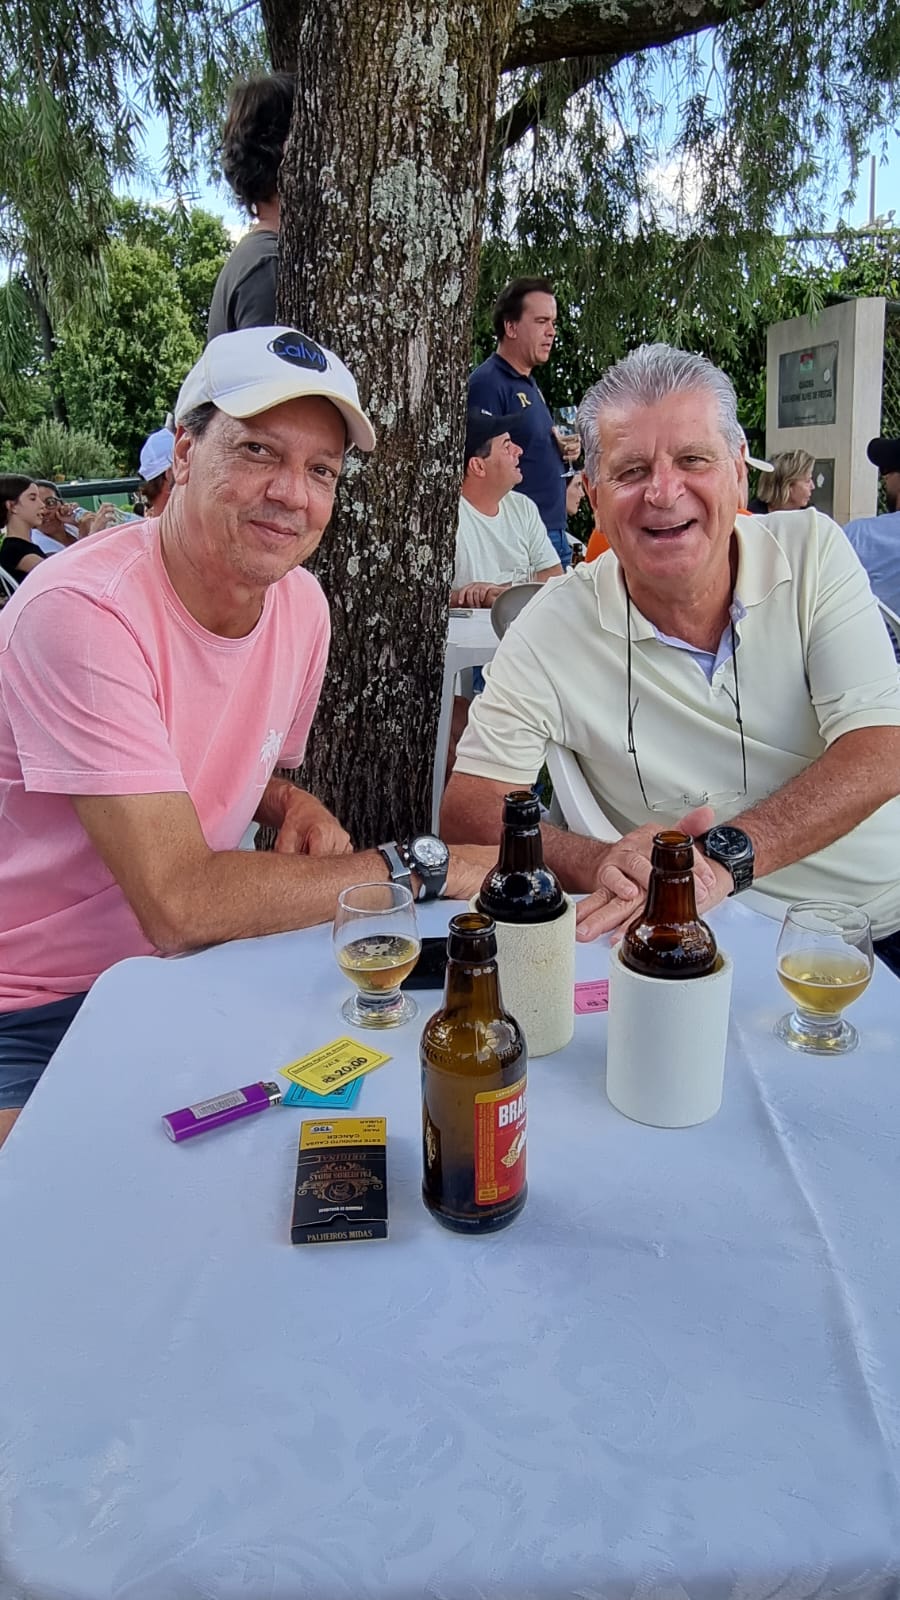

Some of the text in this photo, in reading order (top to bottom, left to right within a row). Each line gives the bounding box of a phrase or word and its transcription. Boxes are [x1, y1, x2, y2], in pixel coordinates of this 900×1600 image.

[335, 1056, 368, 1077] 20,00
[307, 1229, 373, 1242] PALHEIROS MIDAS
